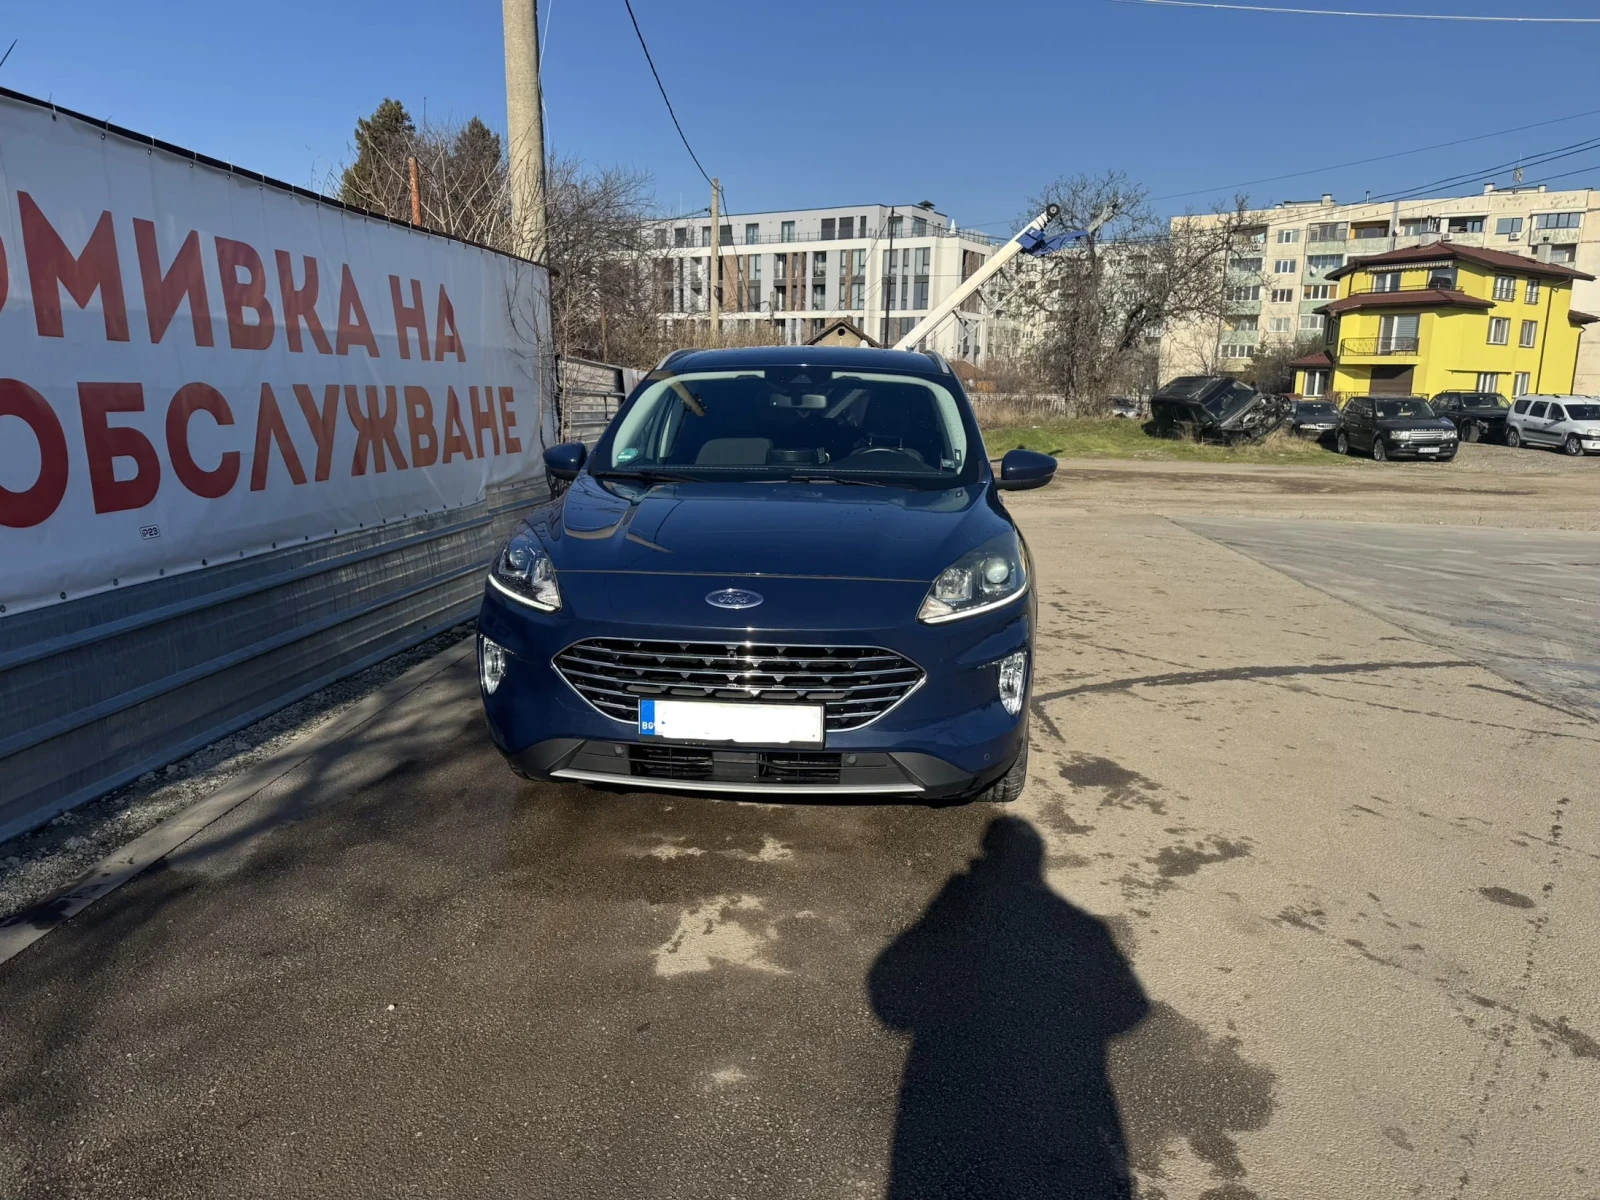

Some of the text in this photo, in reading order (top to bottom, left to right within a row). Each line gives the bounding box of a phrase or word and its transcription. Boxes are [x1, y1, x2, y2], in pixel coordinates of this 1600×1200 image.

[0, 190, 467, 363] МИВКА НА
[0, 377, 522, 528] ОБСЛУЖВАНЕ
[718, 594, 751, 604] Ford
[642, 721, 655, 730] BG
